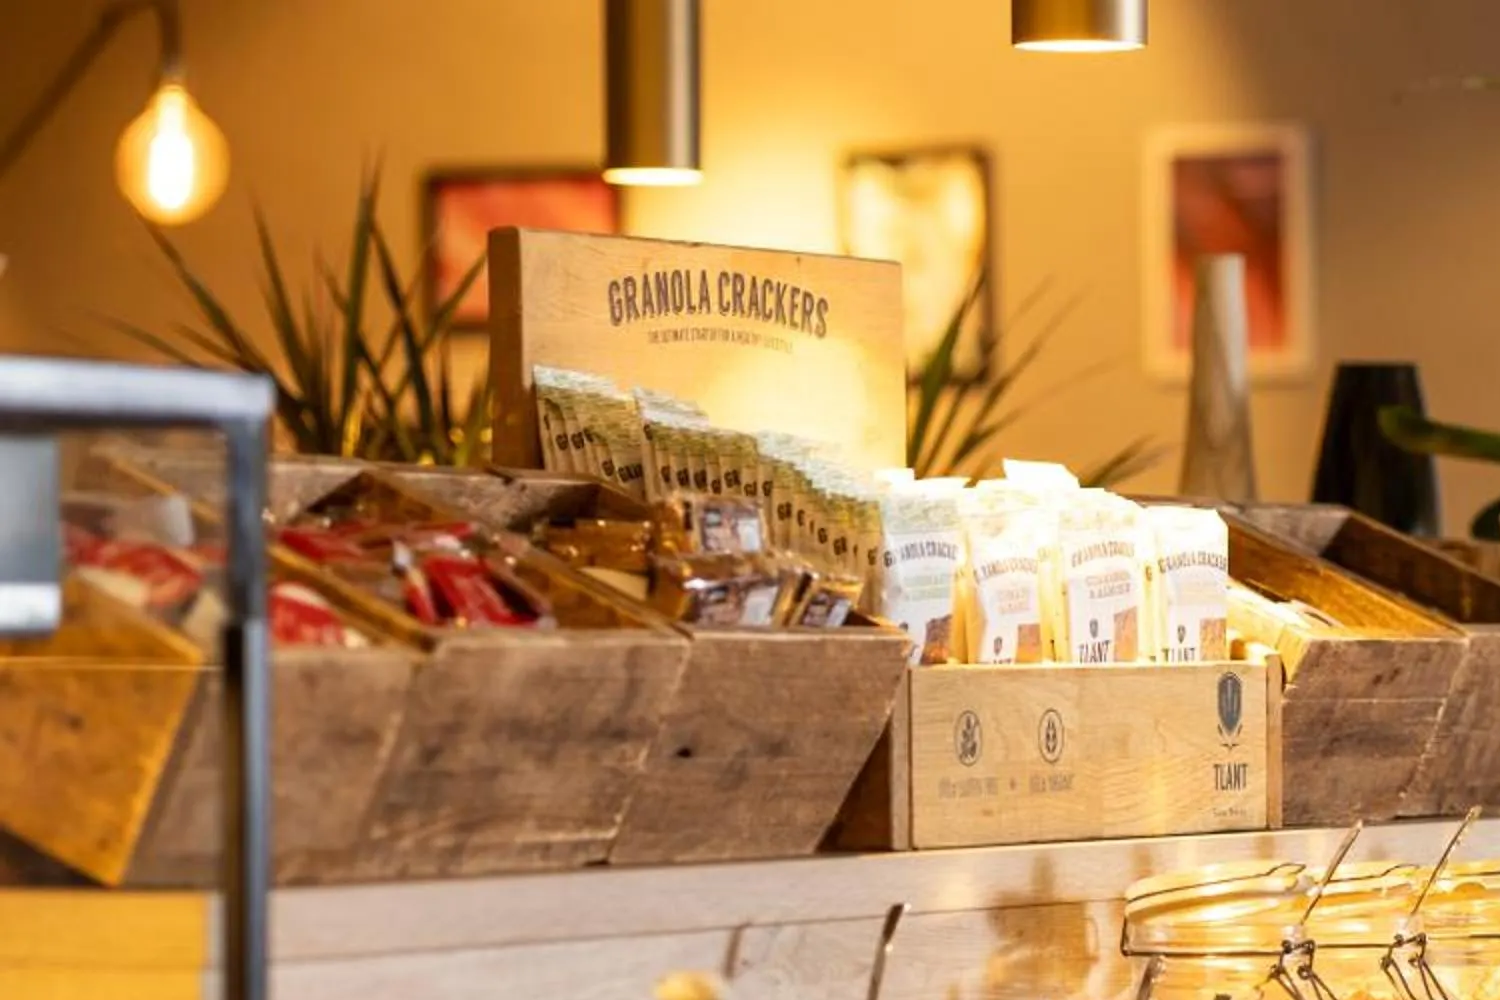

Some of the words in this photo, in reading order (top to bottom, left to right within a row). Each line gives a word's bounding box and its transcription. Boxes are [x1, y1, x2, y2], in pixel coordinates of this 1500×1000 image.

[608, 269, 711, 327] GRANOLA
[717, 270, 829, 340] CRACKERS
[1213, 762, 1249, 791] TLANT
